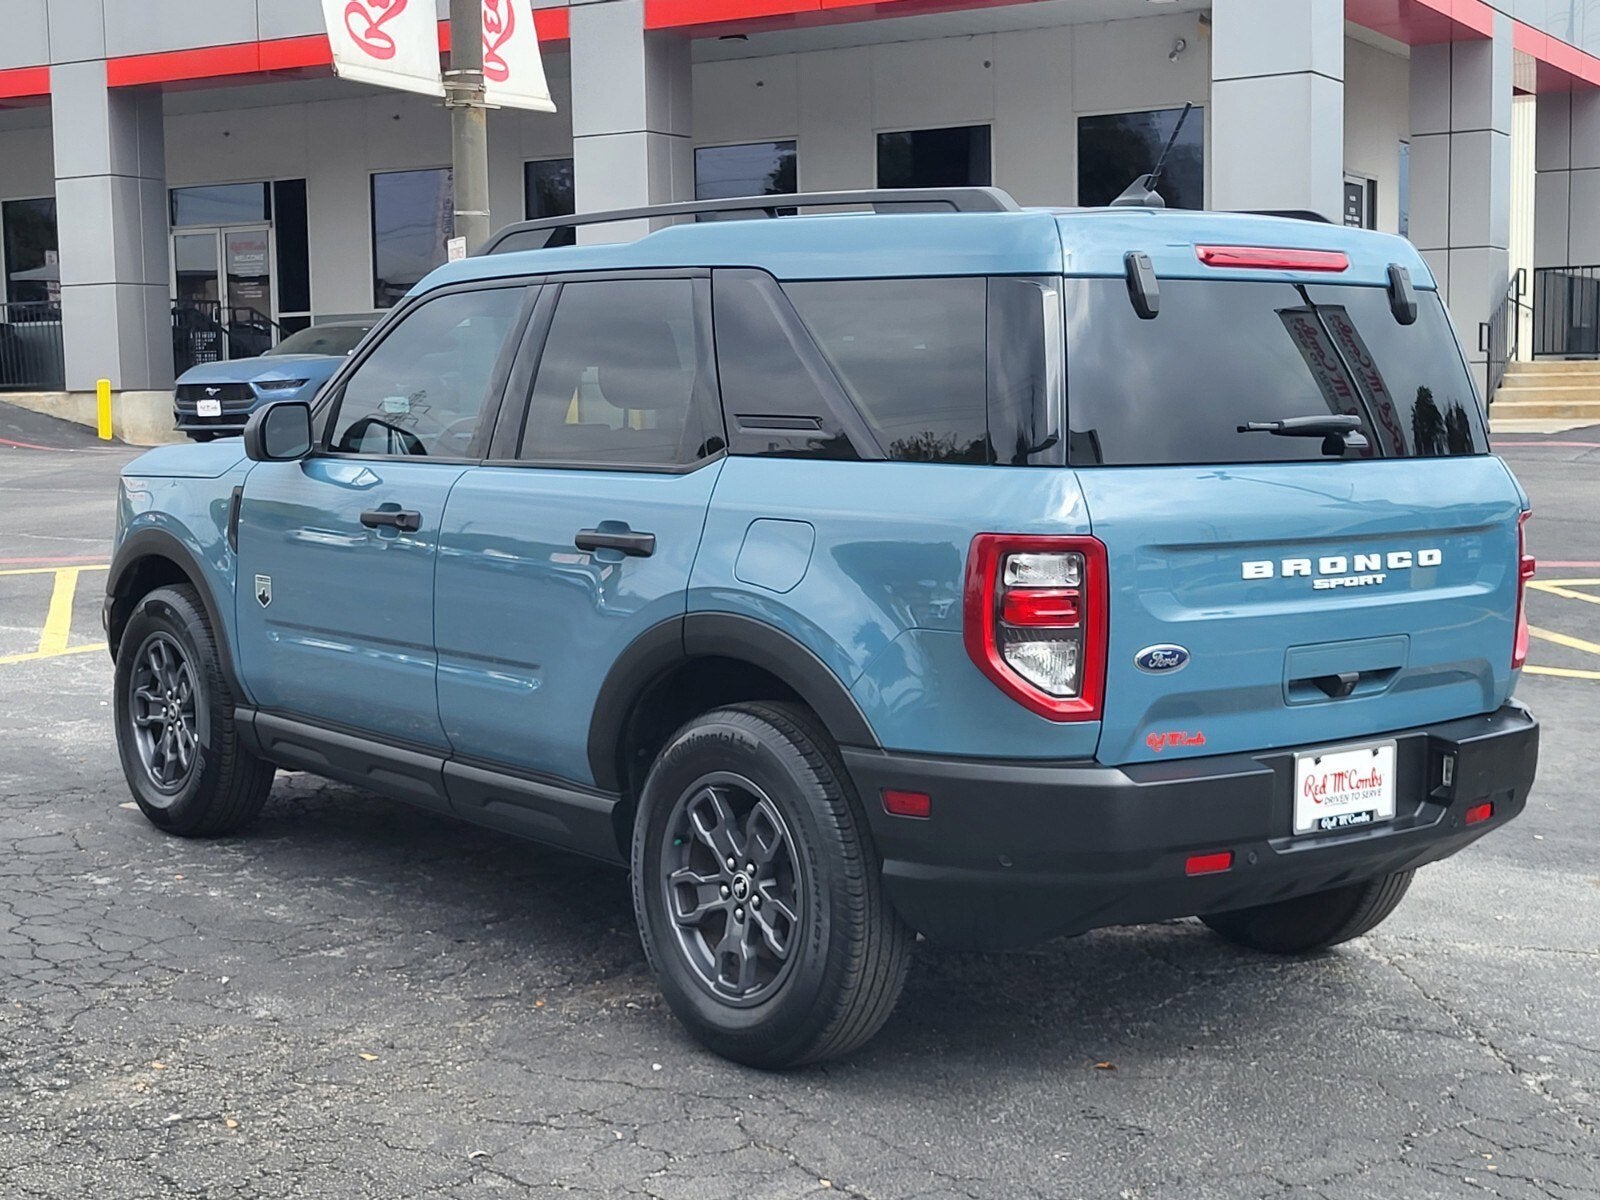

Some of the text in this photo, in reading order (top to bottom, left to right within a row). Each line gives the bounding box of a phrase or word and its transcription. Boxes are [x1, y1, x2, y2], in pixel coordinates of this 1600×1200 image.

[1241, 548, 1443, 580] BRONCO
[1313, 573, 1387, 590] SPORT
[1148, 650, 1179, 668] Ford
[1304, 766, 1383, 804] Red McCombs
[1324, 794, 1350, 805] DRIVEN
[1352, 792, 1361, 801] TO
[1362, 788, 1382, 799] SERVE
